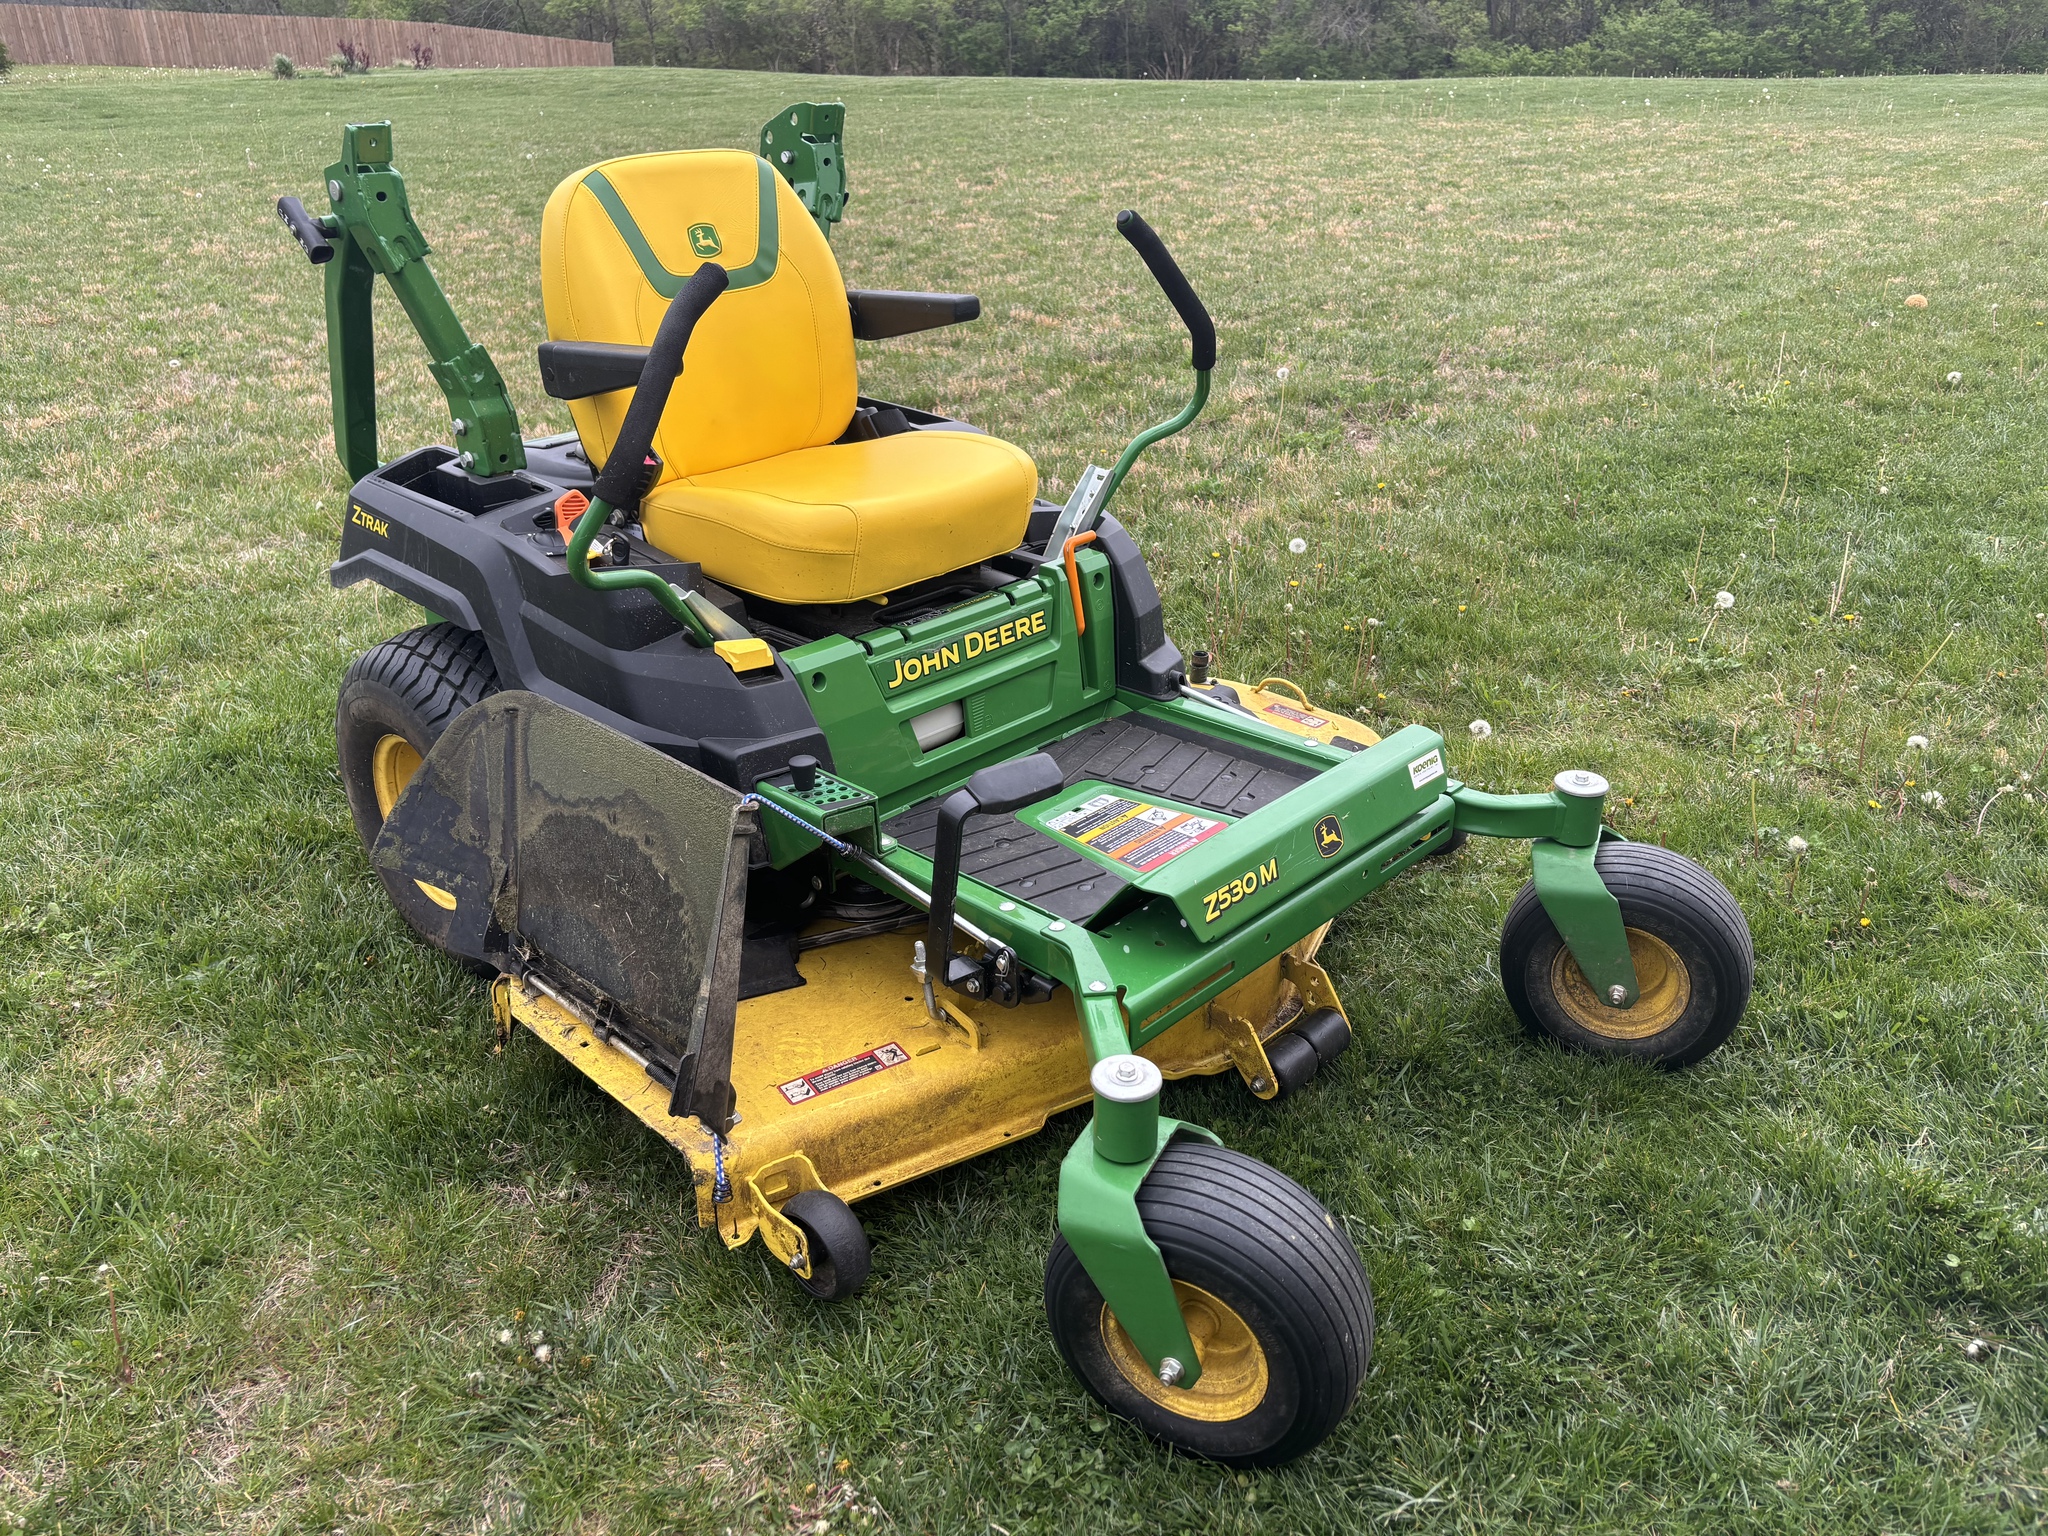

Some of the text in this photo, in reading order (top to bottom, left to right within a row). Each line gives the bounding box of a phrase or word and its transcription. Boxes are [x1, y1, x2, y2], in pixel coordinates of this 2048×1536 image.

[352, 504, 389, 538] ZTRAK
[888, 610, 1047, 689] JOHN DEERE
[1203, 858, 1279, 923] Z530 M
[828, 1056, 858, 1070] DANGER
